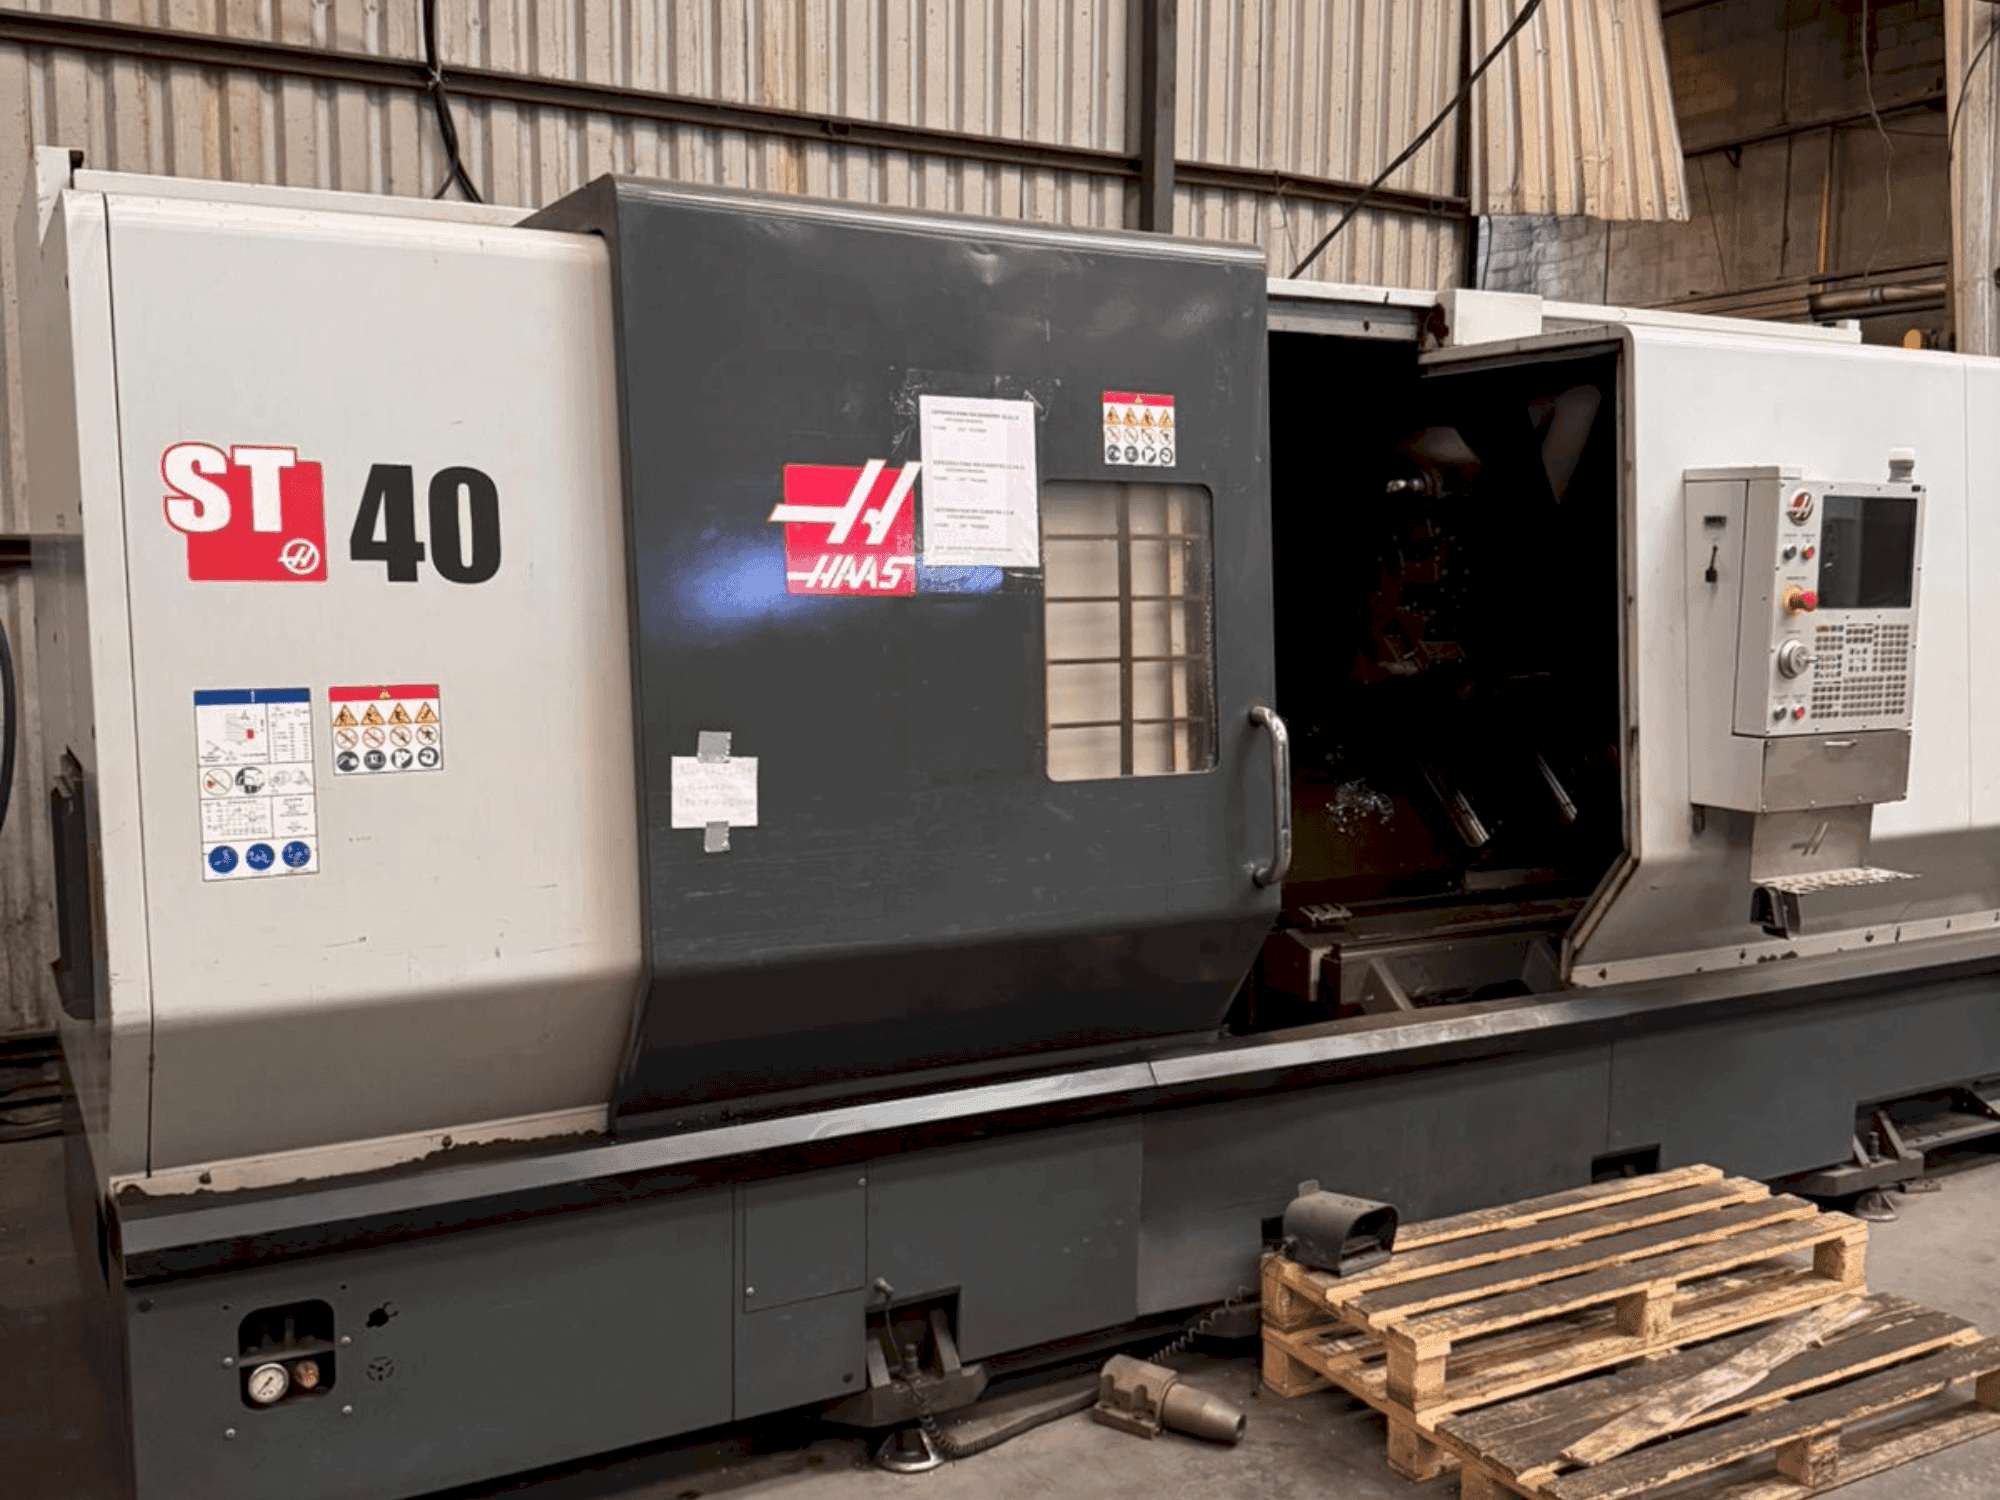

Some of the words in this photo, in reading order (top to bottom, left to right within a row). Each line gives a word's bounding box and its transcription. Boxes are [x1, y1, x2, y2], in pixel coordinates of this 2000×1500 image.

[162, 442, 297, 534] ST
[349, 463, 503, 584] 40
[786, 554, 916, 589] HAAS
